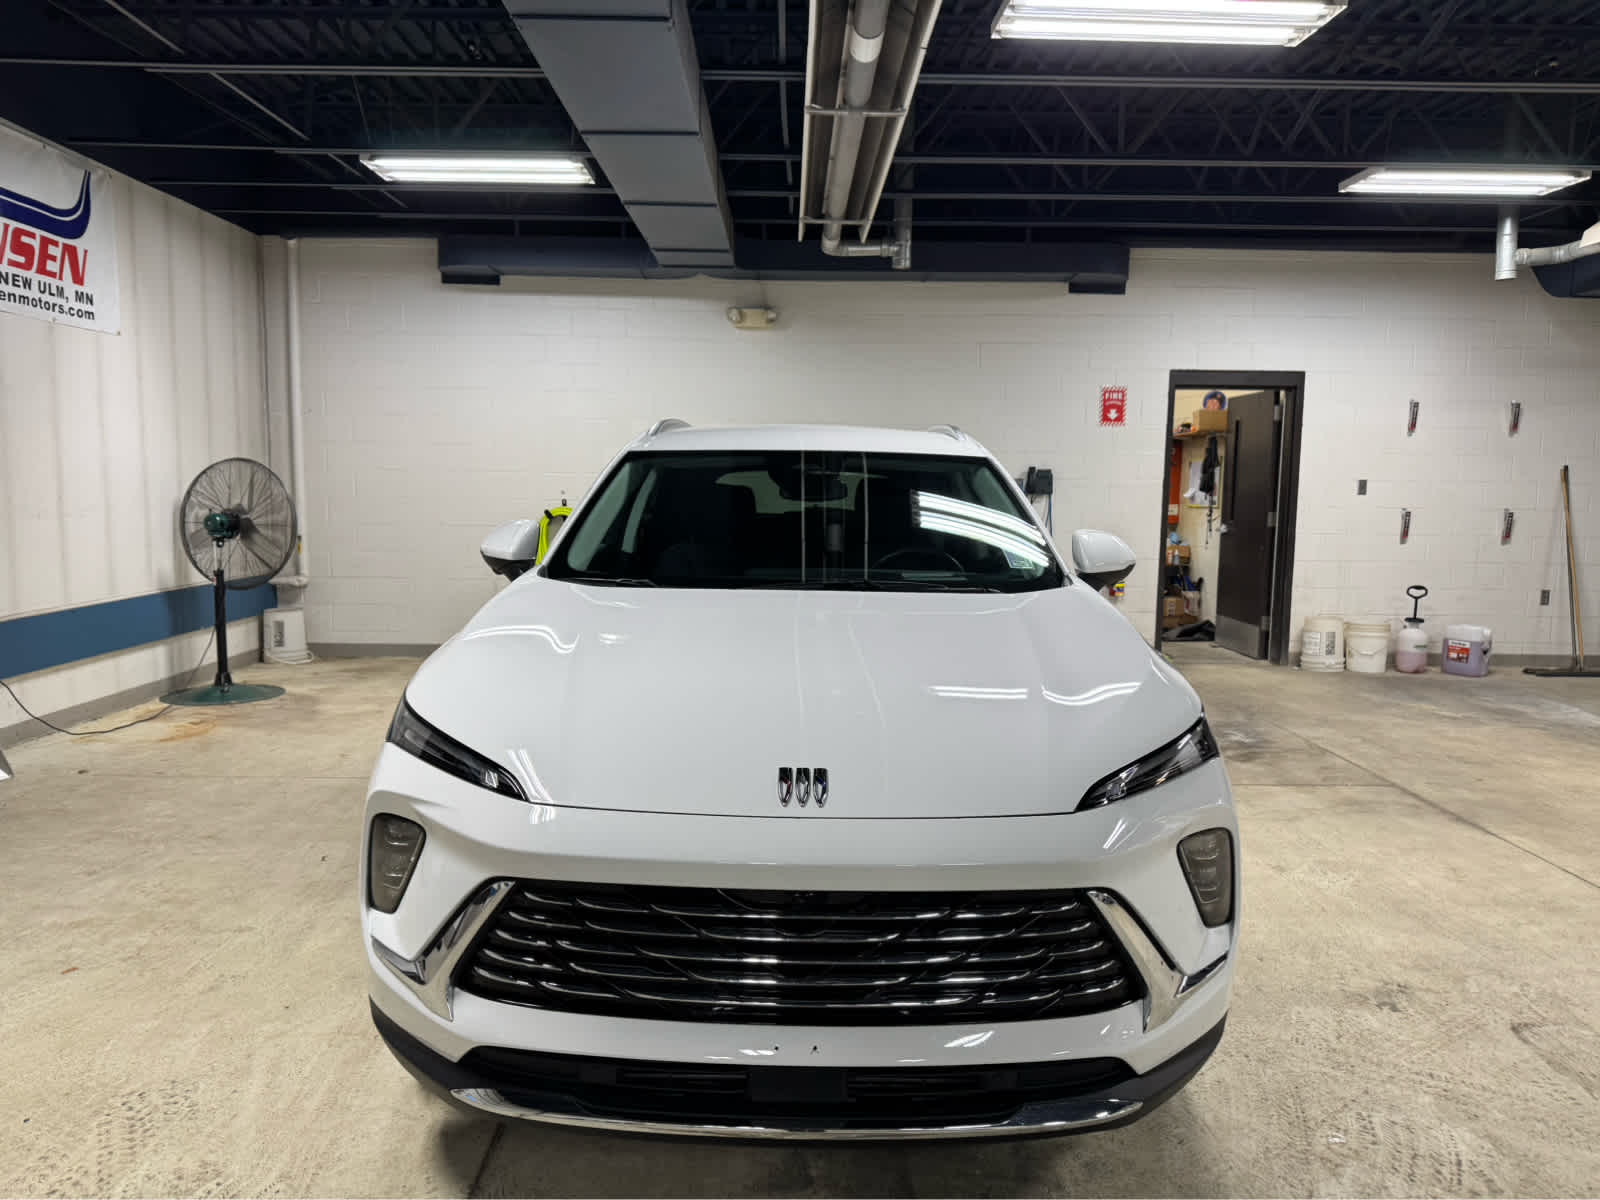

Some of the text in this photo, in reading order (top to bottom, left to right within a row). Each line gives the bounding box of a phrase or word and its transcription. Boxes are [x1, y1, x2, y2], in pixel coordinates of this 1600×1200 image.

[0, 271, 94, 306] NEW ULM, MN
[0, 290, 95, 320] enmotors.com
